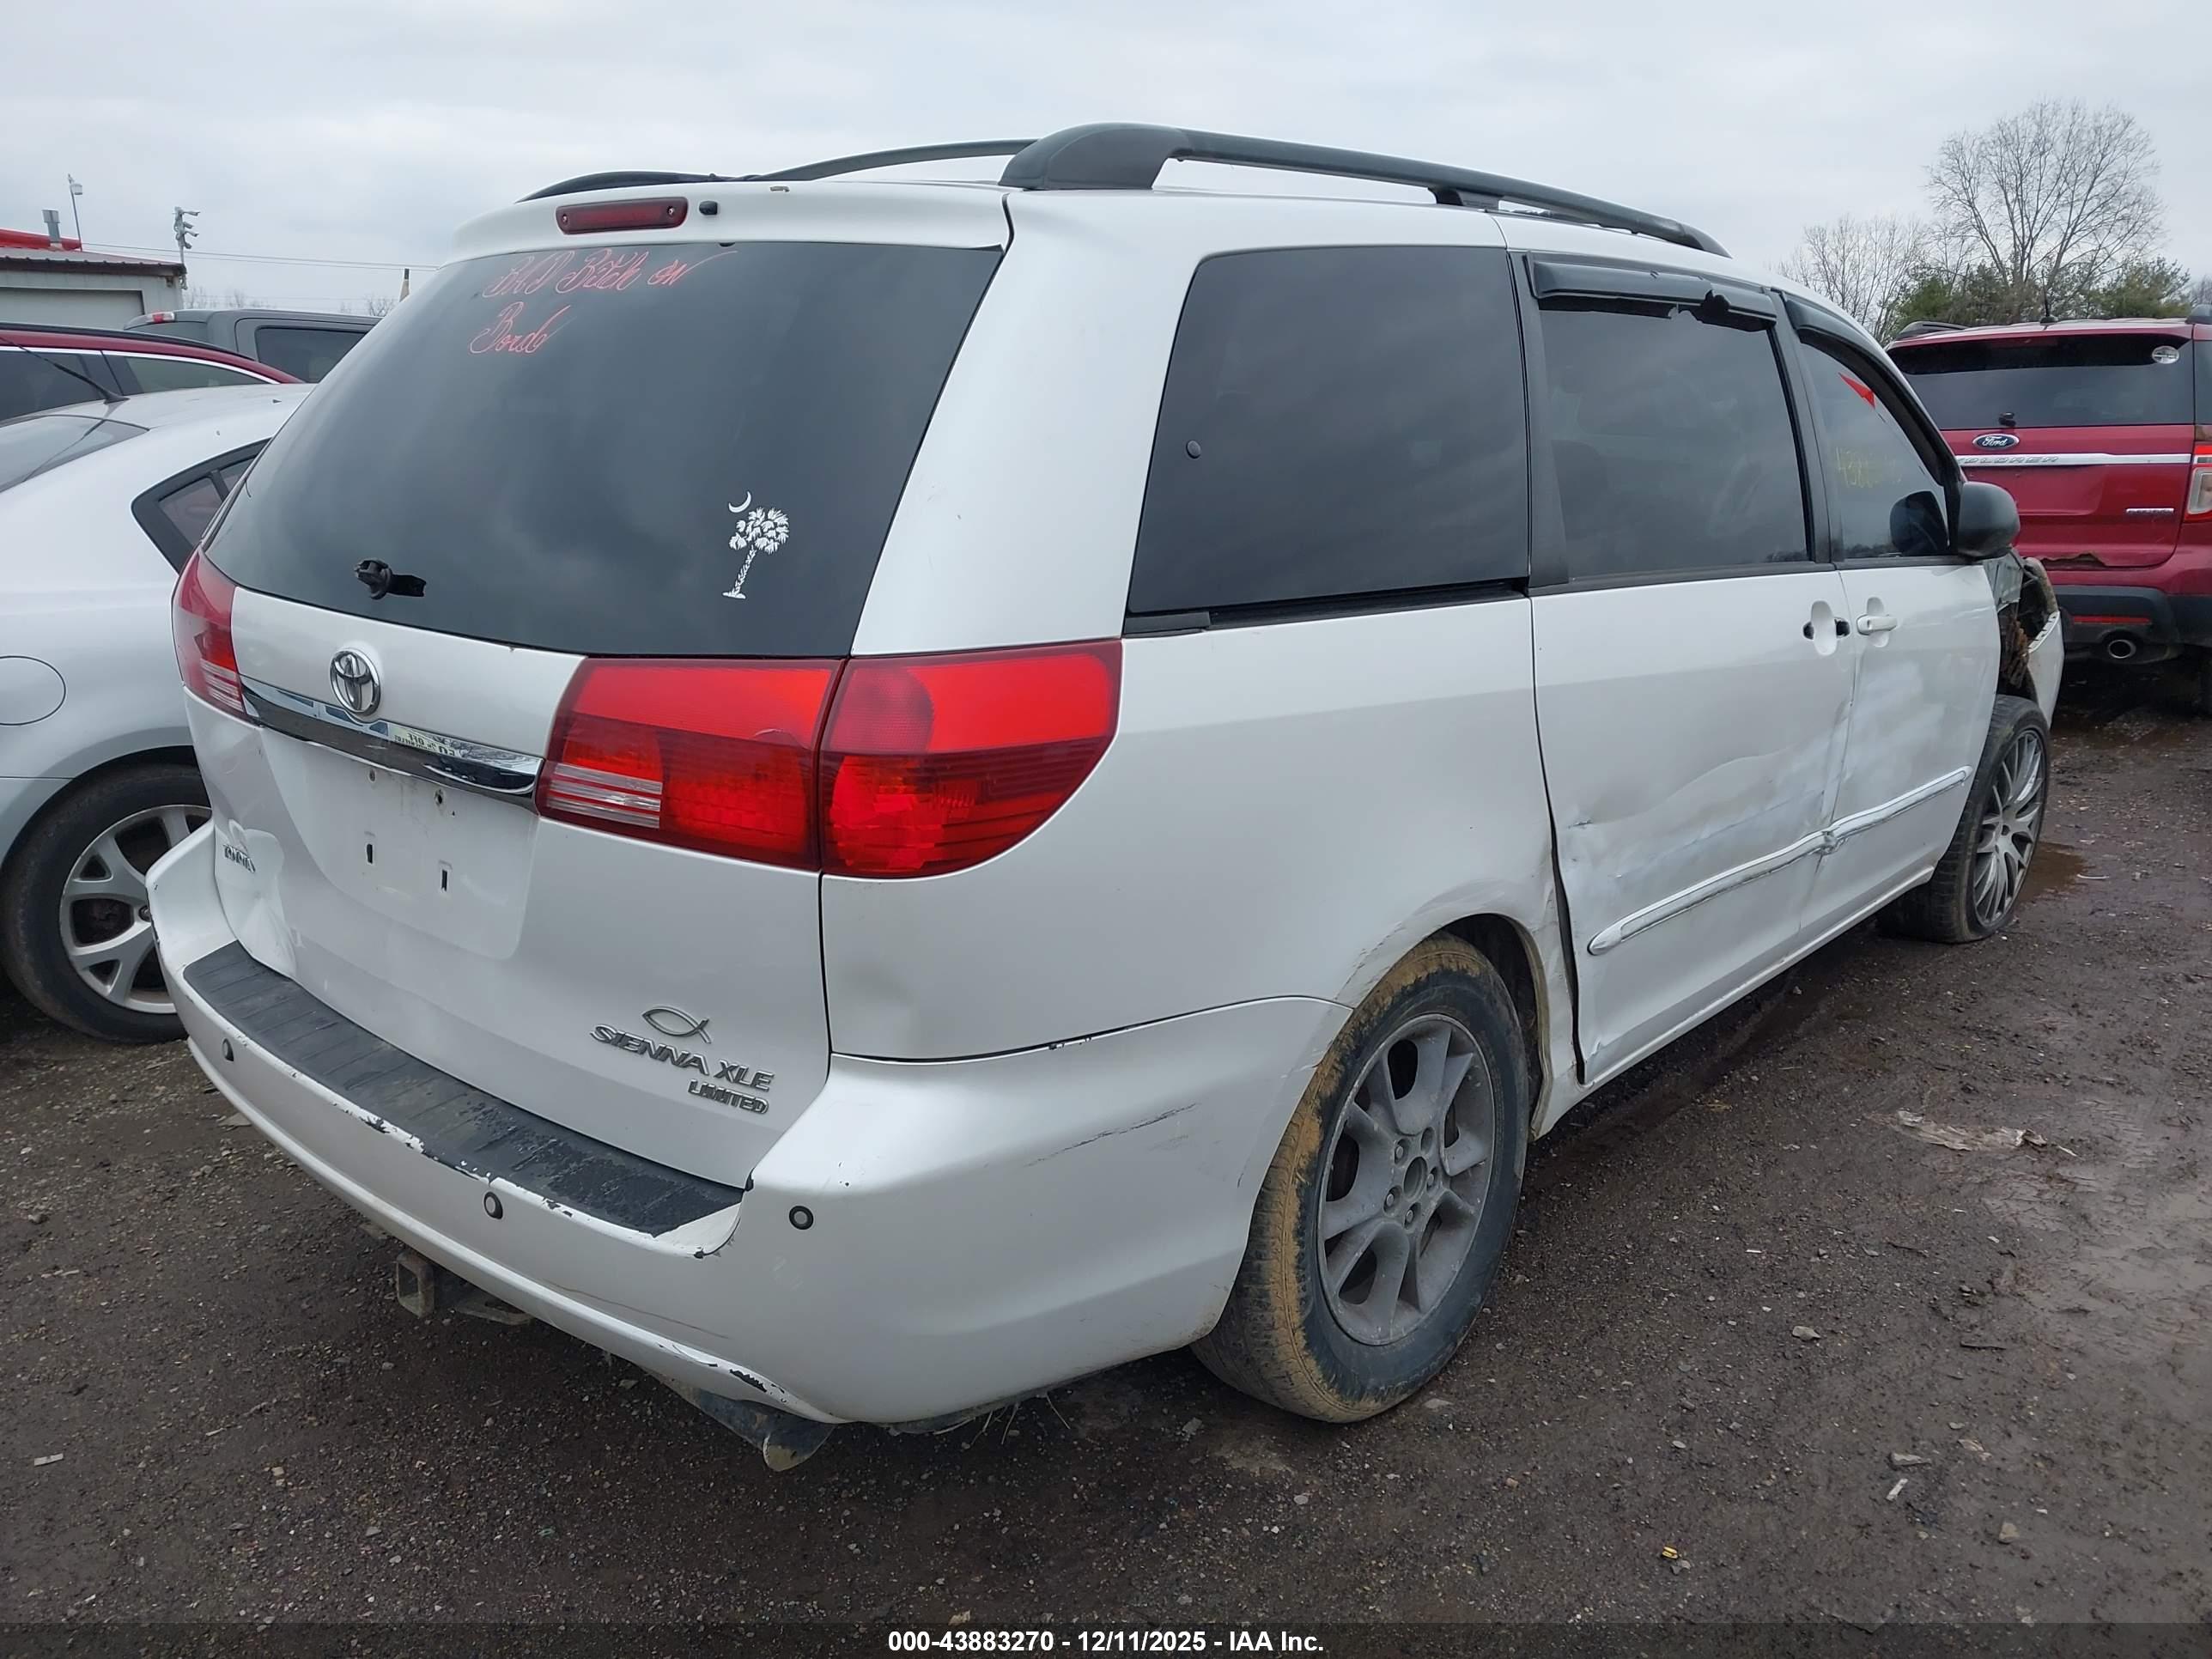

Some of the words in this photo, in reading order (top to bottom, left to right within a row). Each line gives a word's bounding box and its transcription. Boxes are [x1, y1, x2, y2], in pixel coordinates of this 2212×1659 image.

[1981, 436, 2008, 447] Ford
[590, 1024, 710, 1075] SIENNA
[714, 1058, 775, 1091] XLE
[688, 1078, 769, 1115] LIMITED
